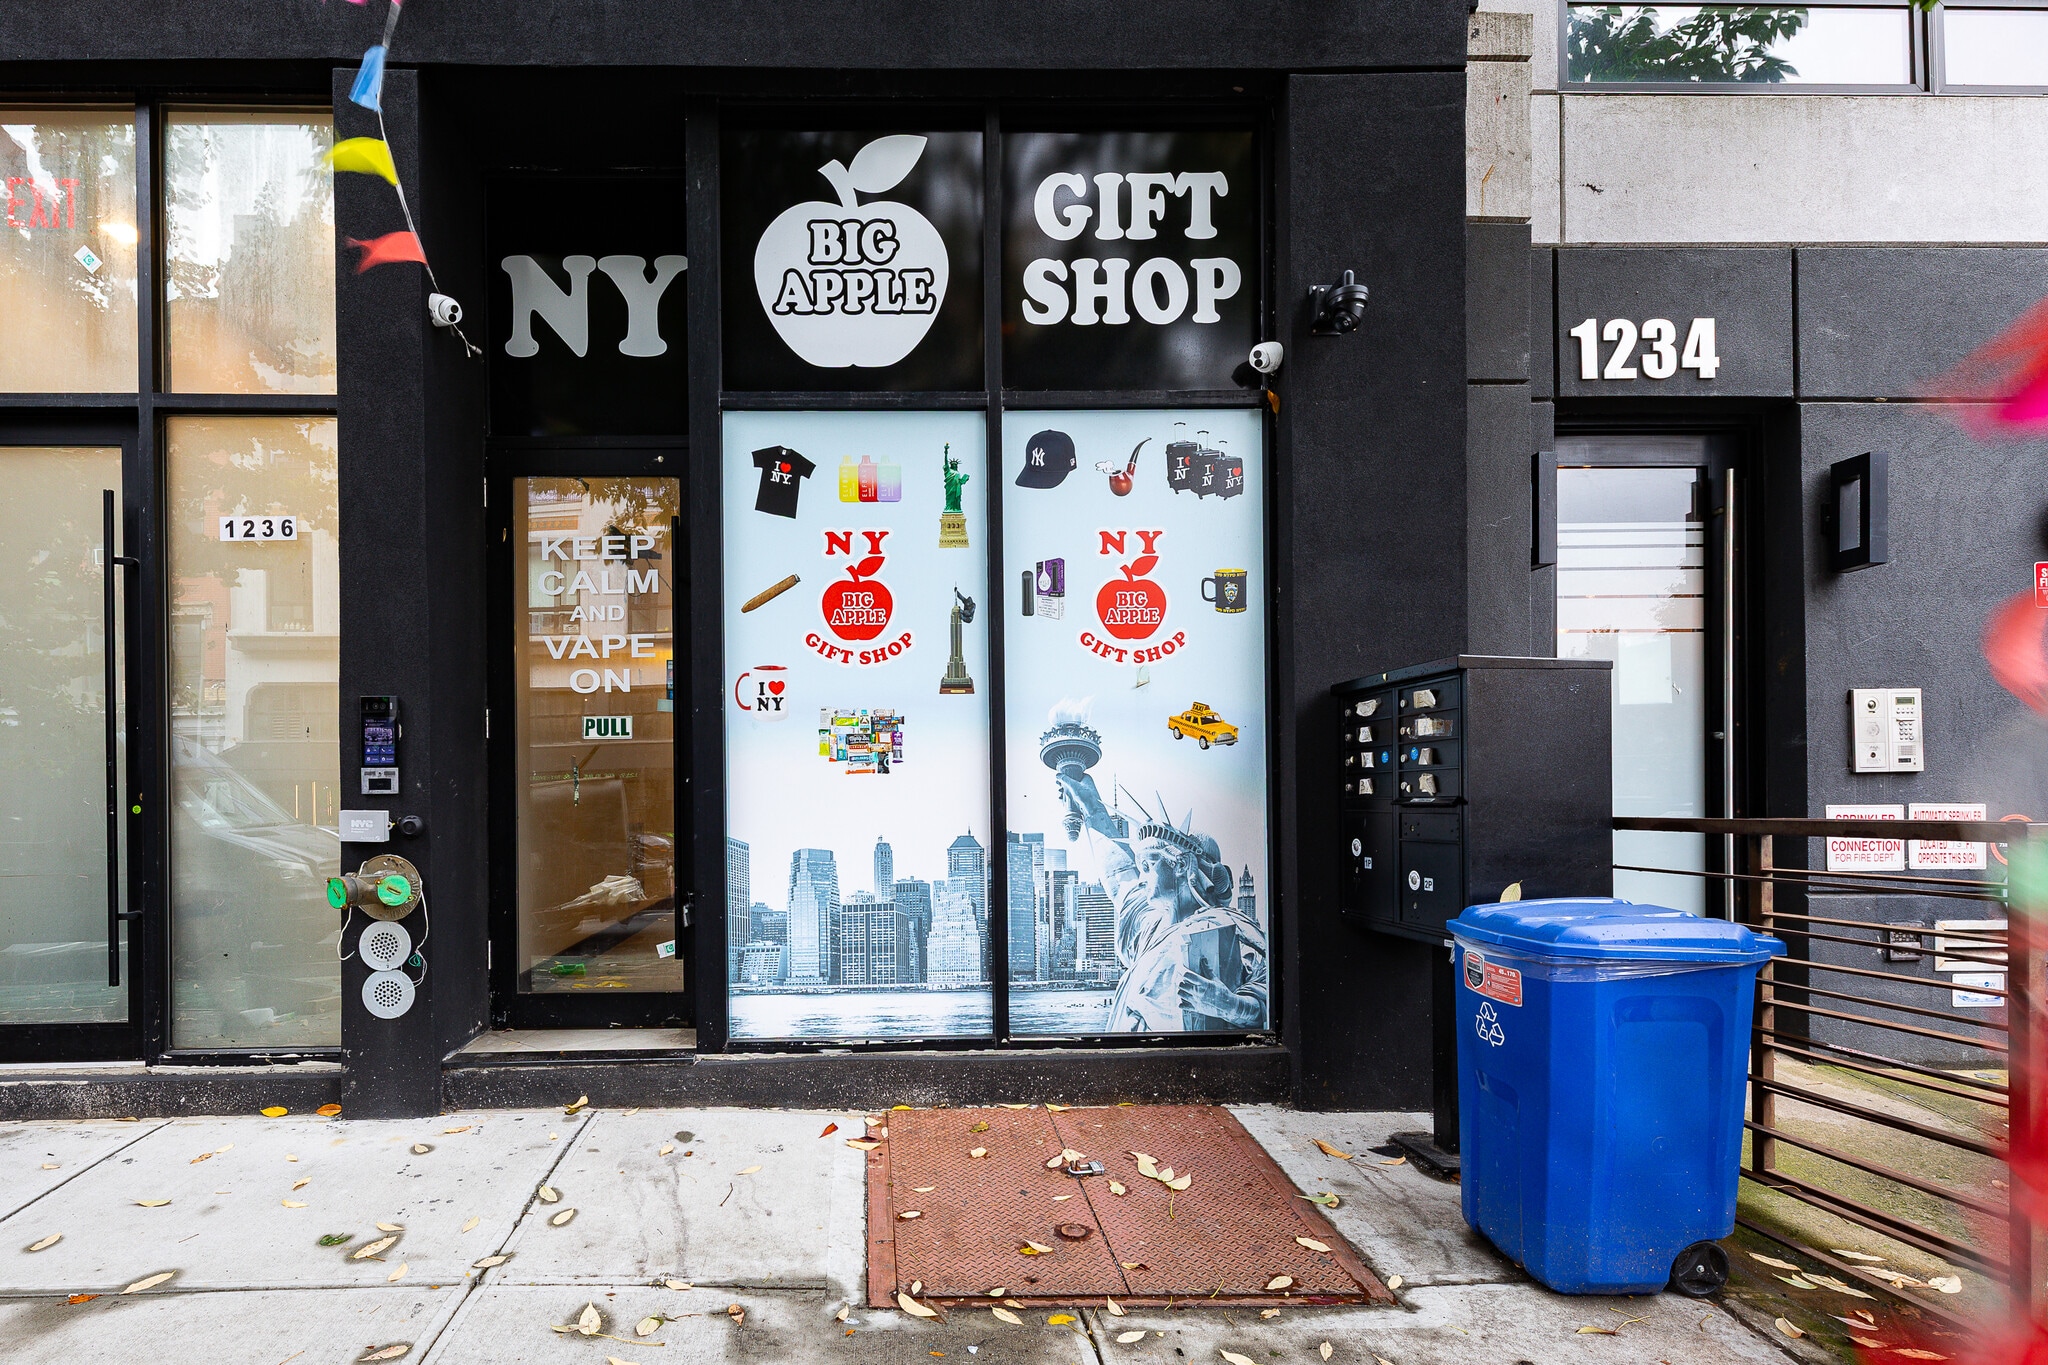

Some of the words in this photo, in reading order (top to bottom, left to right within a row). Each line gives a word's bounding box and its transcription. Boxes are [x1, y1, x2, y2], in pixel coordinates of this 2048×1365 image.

[7, 177, 80, 229] EXIT
[1034, 171, 1229, 241] GIFT
[807, 218, 900, 266] BIG
[772, 268, 937, 316] APPLE
[1022, 257, 1241, 326] SHOP
[501, 254, 688, 357] NY
[1570, 317, 1720, 380] 1234
[224, 518, 294, 539] 1236
[540, 535, 656, 561] KEEP
[537, 569, 659, 596] CALM
[842, 592, 875, 608] BIG
[1116, 592, 1149, 608] BIG
[569, 605, 625, 622] AND
[831, 609, 886, 626] APPLE
[1105, 608, 1160, 626] APPLE
[542, 633, 656, 660] VAPE
[805, 633, 854, 665] GIFT
[859, 632, 914, 665] SHOP
[1079, 632, 1128, 664] GIFT
[1133, 631, 1187, 664] SHOP
[569, 668, 631, 694] ON
[758, 681, 766, 696] I
[757, 697, 785, 712] NY
[1192, 703, 1205, 712] TAXI
[584, 718, 630, 737] PULL
[351, 819, 374, 828] NYC
[1913, 810, 1947, 821] AUTOMATIC
[1948, 810, 1982, 821] SPRINKLER
[1831, 840, 1901, 852] CONNECTION
[1919, 841, 1948, 850] LOCATED
[1365, 859, 1372, 867] 1P
[1835, 853, 1852, 863] FOR
[1854, 853, 1872, 863] FIRE
[1873, 853, 1897, 863] DEPT.
[1918, 852, 1947, 864] OPPOSITE
[1948, 852, 1962, 864] THIS
[1963, 852, 1978, 864] SIGN
[1424, 880, 1433, 889] 2P
